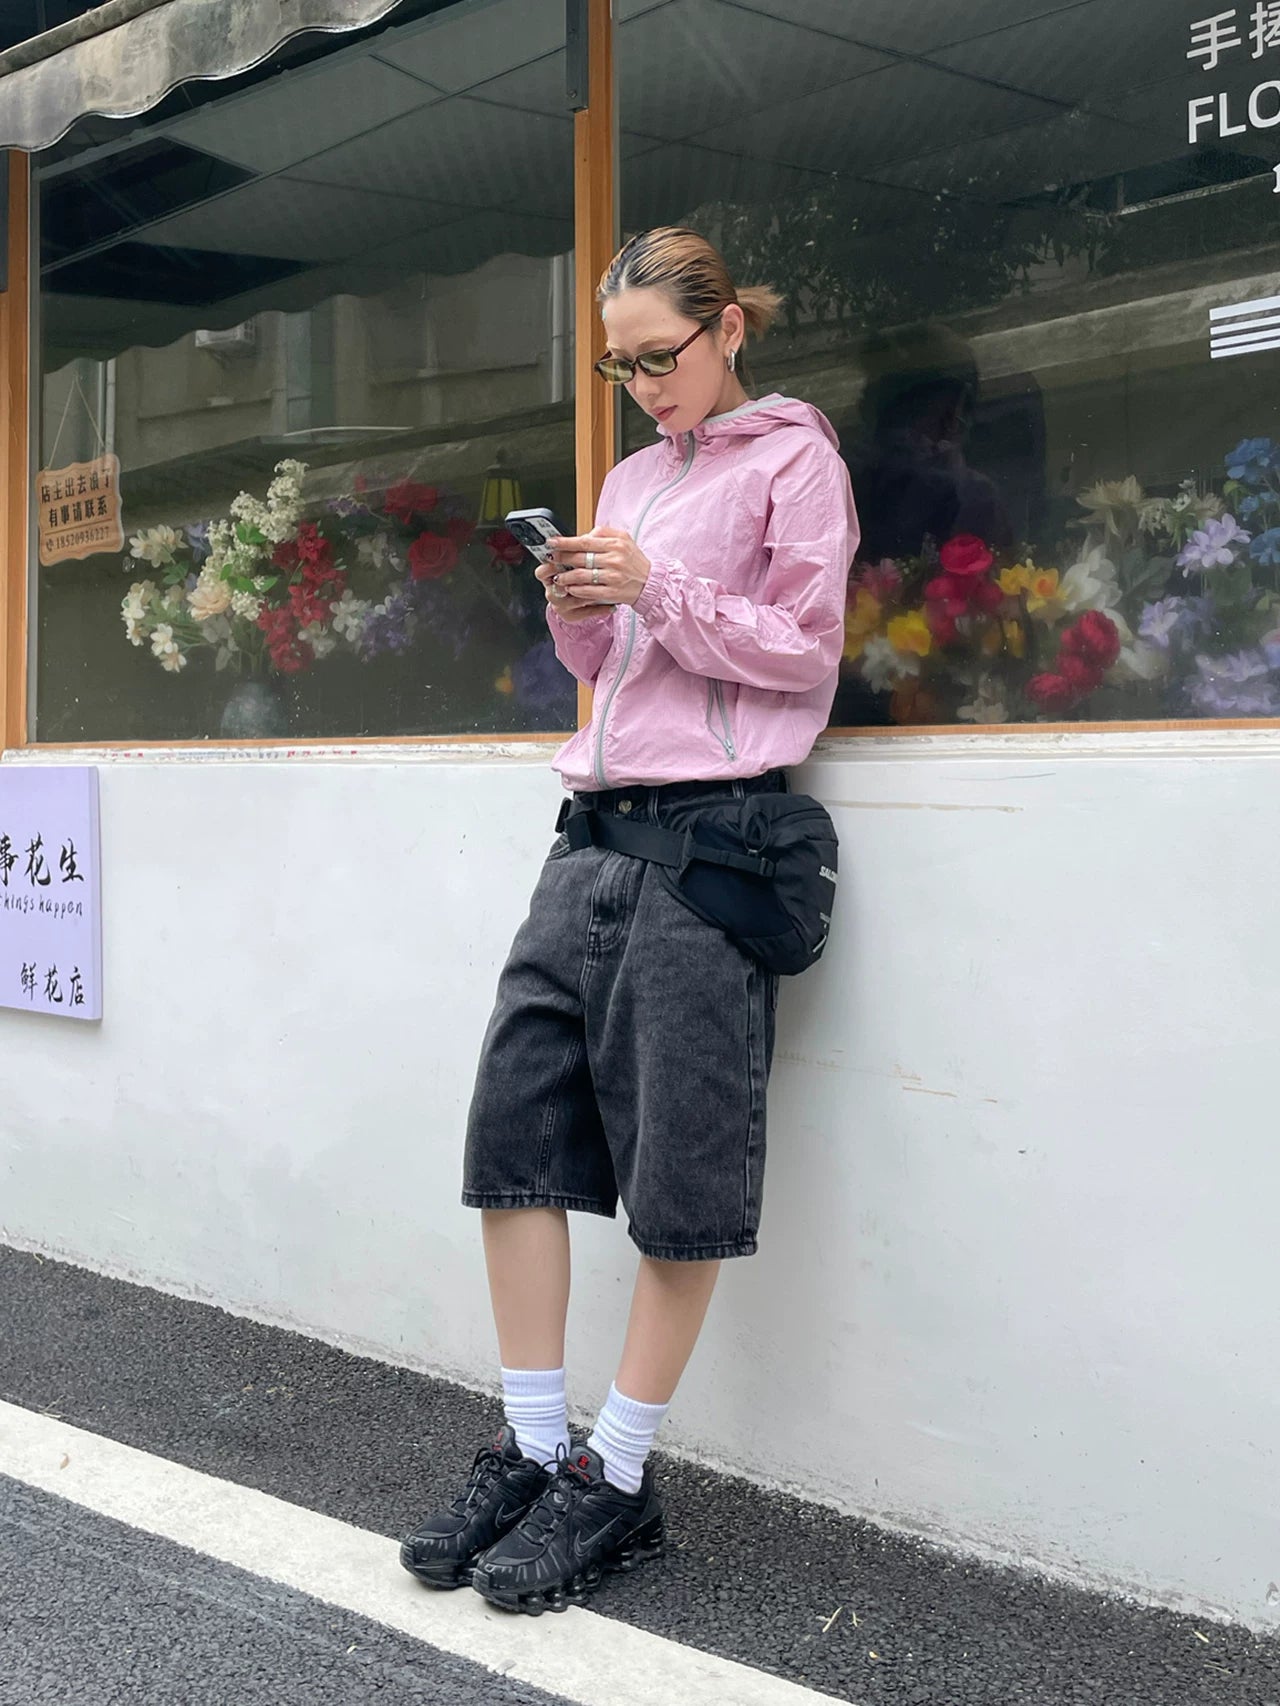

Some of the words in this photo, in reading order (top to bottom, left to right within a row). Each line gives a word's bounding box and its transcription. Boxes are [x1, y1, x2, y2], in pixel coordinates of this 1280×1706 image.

[1188, 80, 1280, 144] FLO
[49, 495, 108, 528] 有事请联系
[0, 891, 35, 914] hings
[39, 894, 82, 919] happen
[20, 962, 85, 1006] 鲜花店
